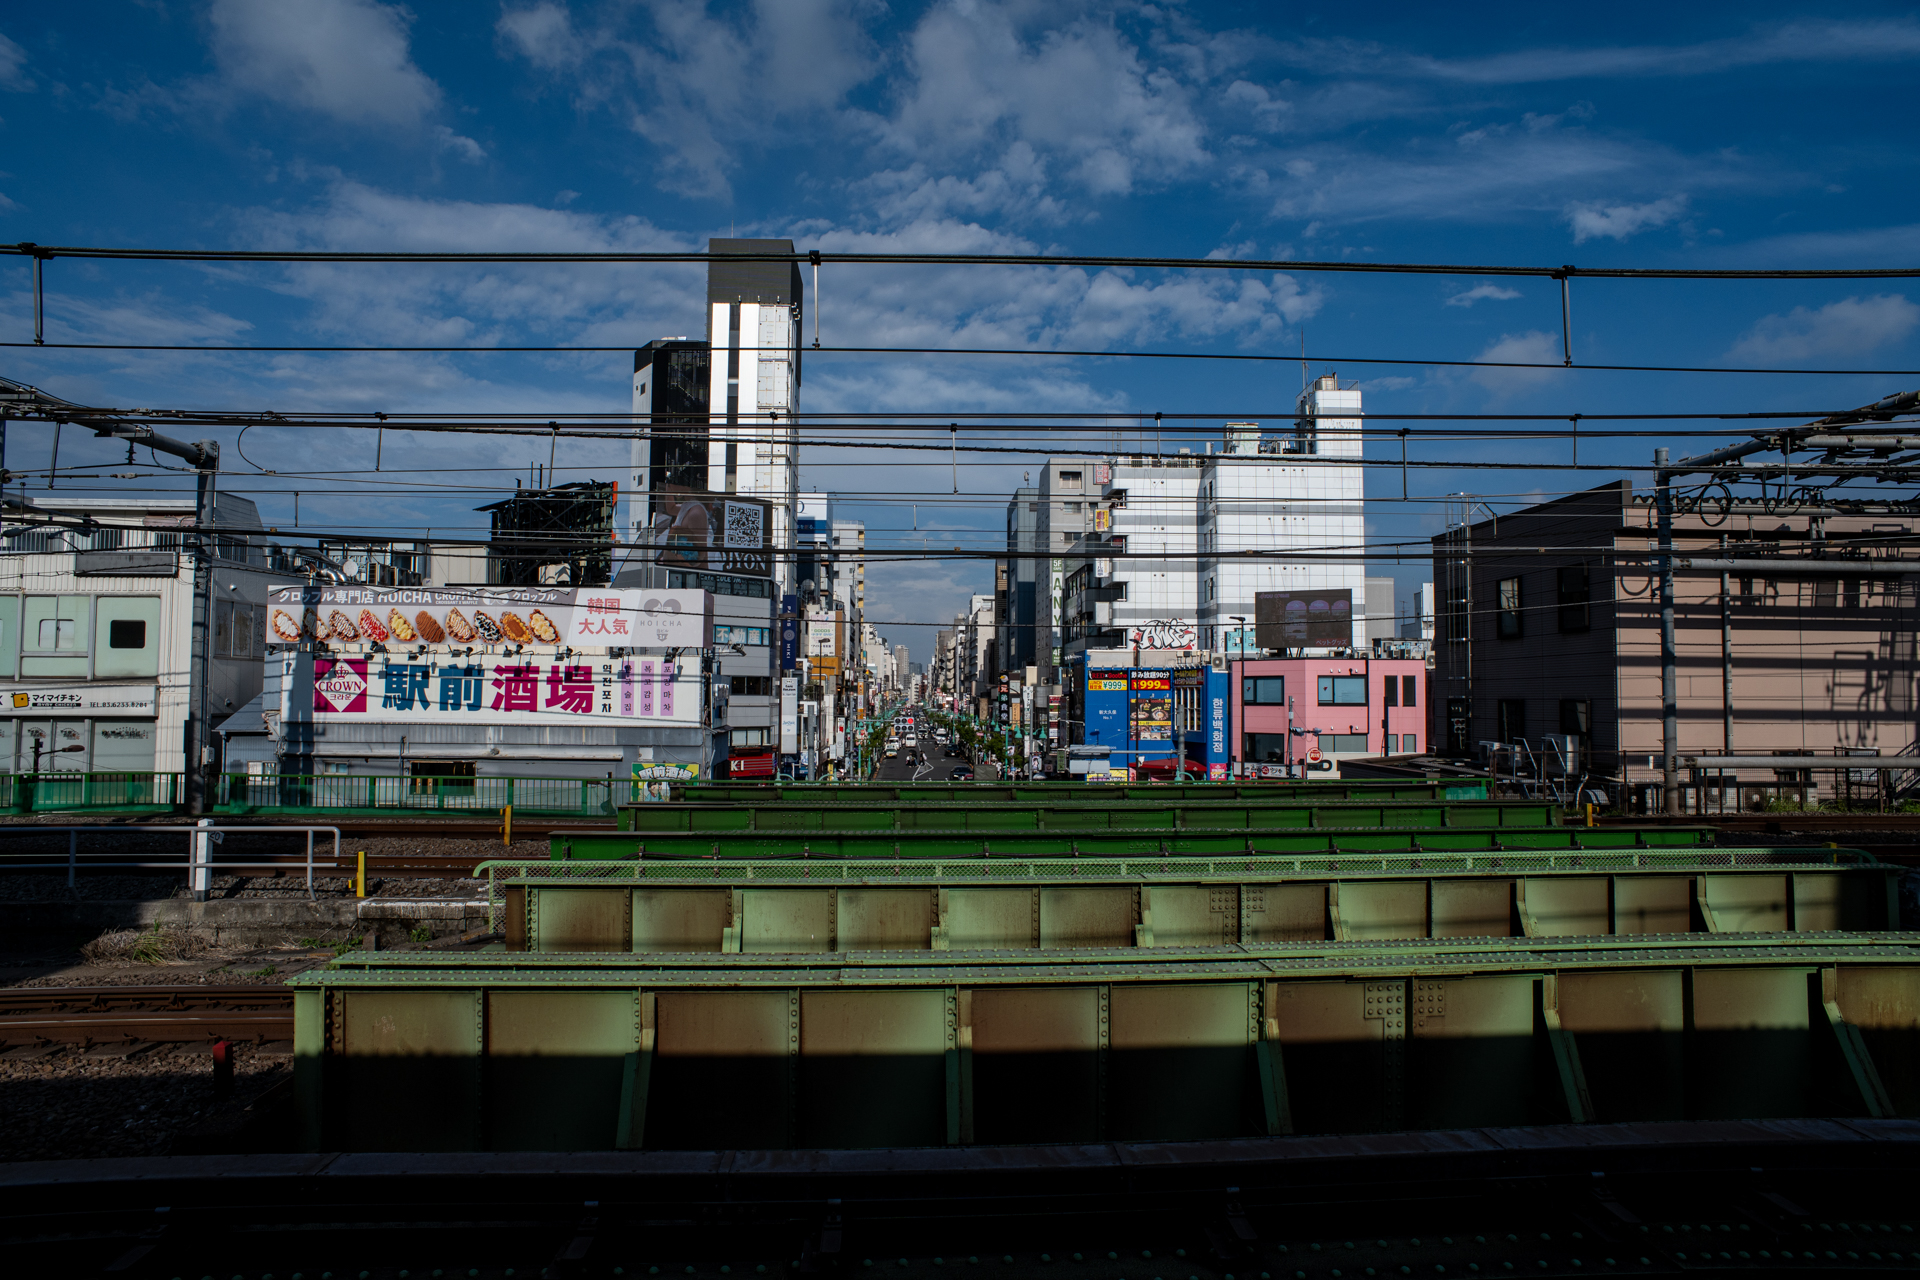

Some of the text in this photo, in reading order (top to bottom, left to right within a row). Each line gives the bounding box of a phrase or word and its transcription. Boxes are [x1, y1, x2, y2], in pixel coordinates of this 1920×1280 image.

[1053, 559, 1062, 567] 5F
[279, 590, 374, 604] クロッフル専門店
[378, 591, 432, 604] HOICHA
[435, 591, 479, 601] CROFFLE
[512, 591, 557, 602] クロッフル
[1053, 577, 1062, 626] ANY
[587, 597, 621, 615] 韓国
[578, 618, 629, 635] 大人気
[1052, 648, 1062, 656] 4F
[318, 681, 362, 692] CROWN
[383, 665, 595, 712] 駅前酒場
[601, 664, 613, 713] 역전포차
[643, 665, 652, 712] 복고감성
[663, 665, 671, 712] 포장마차
[32, 694, 82, 702] マイマイチキン
[1212, 698, 1224, 753] 한류백화점
[638, 765, 693, 780] 駅前酒場
